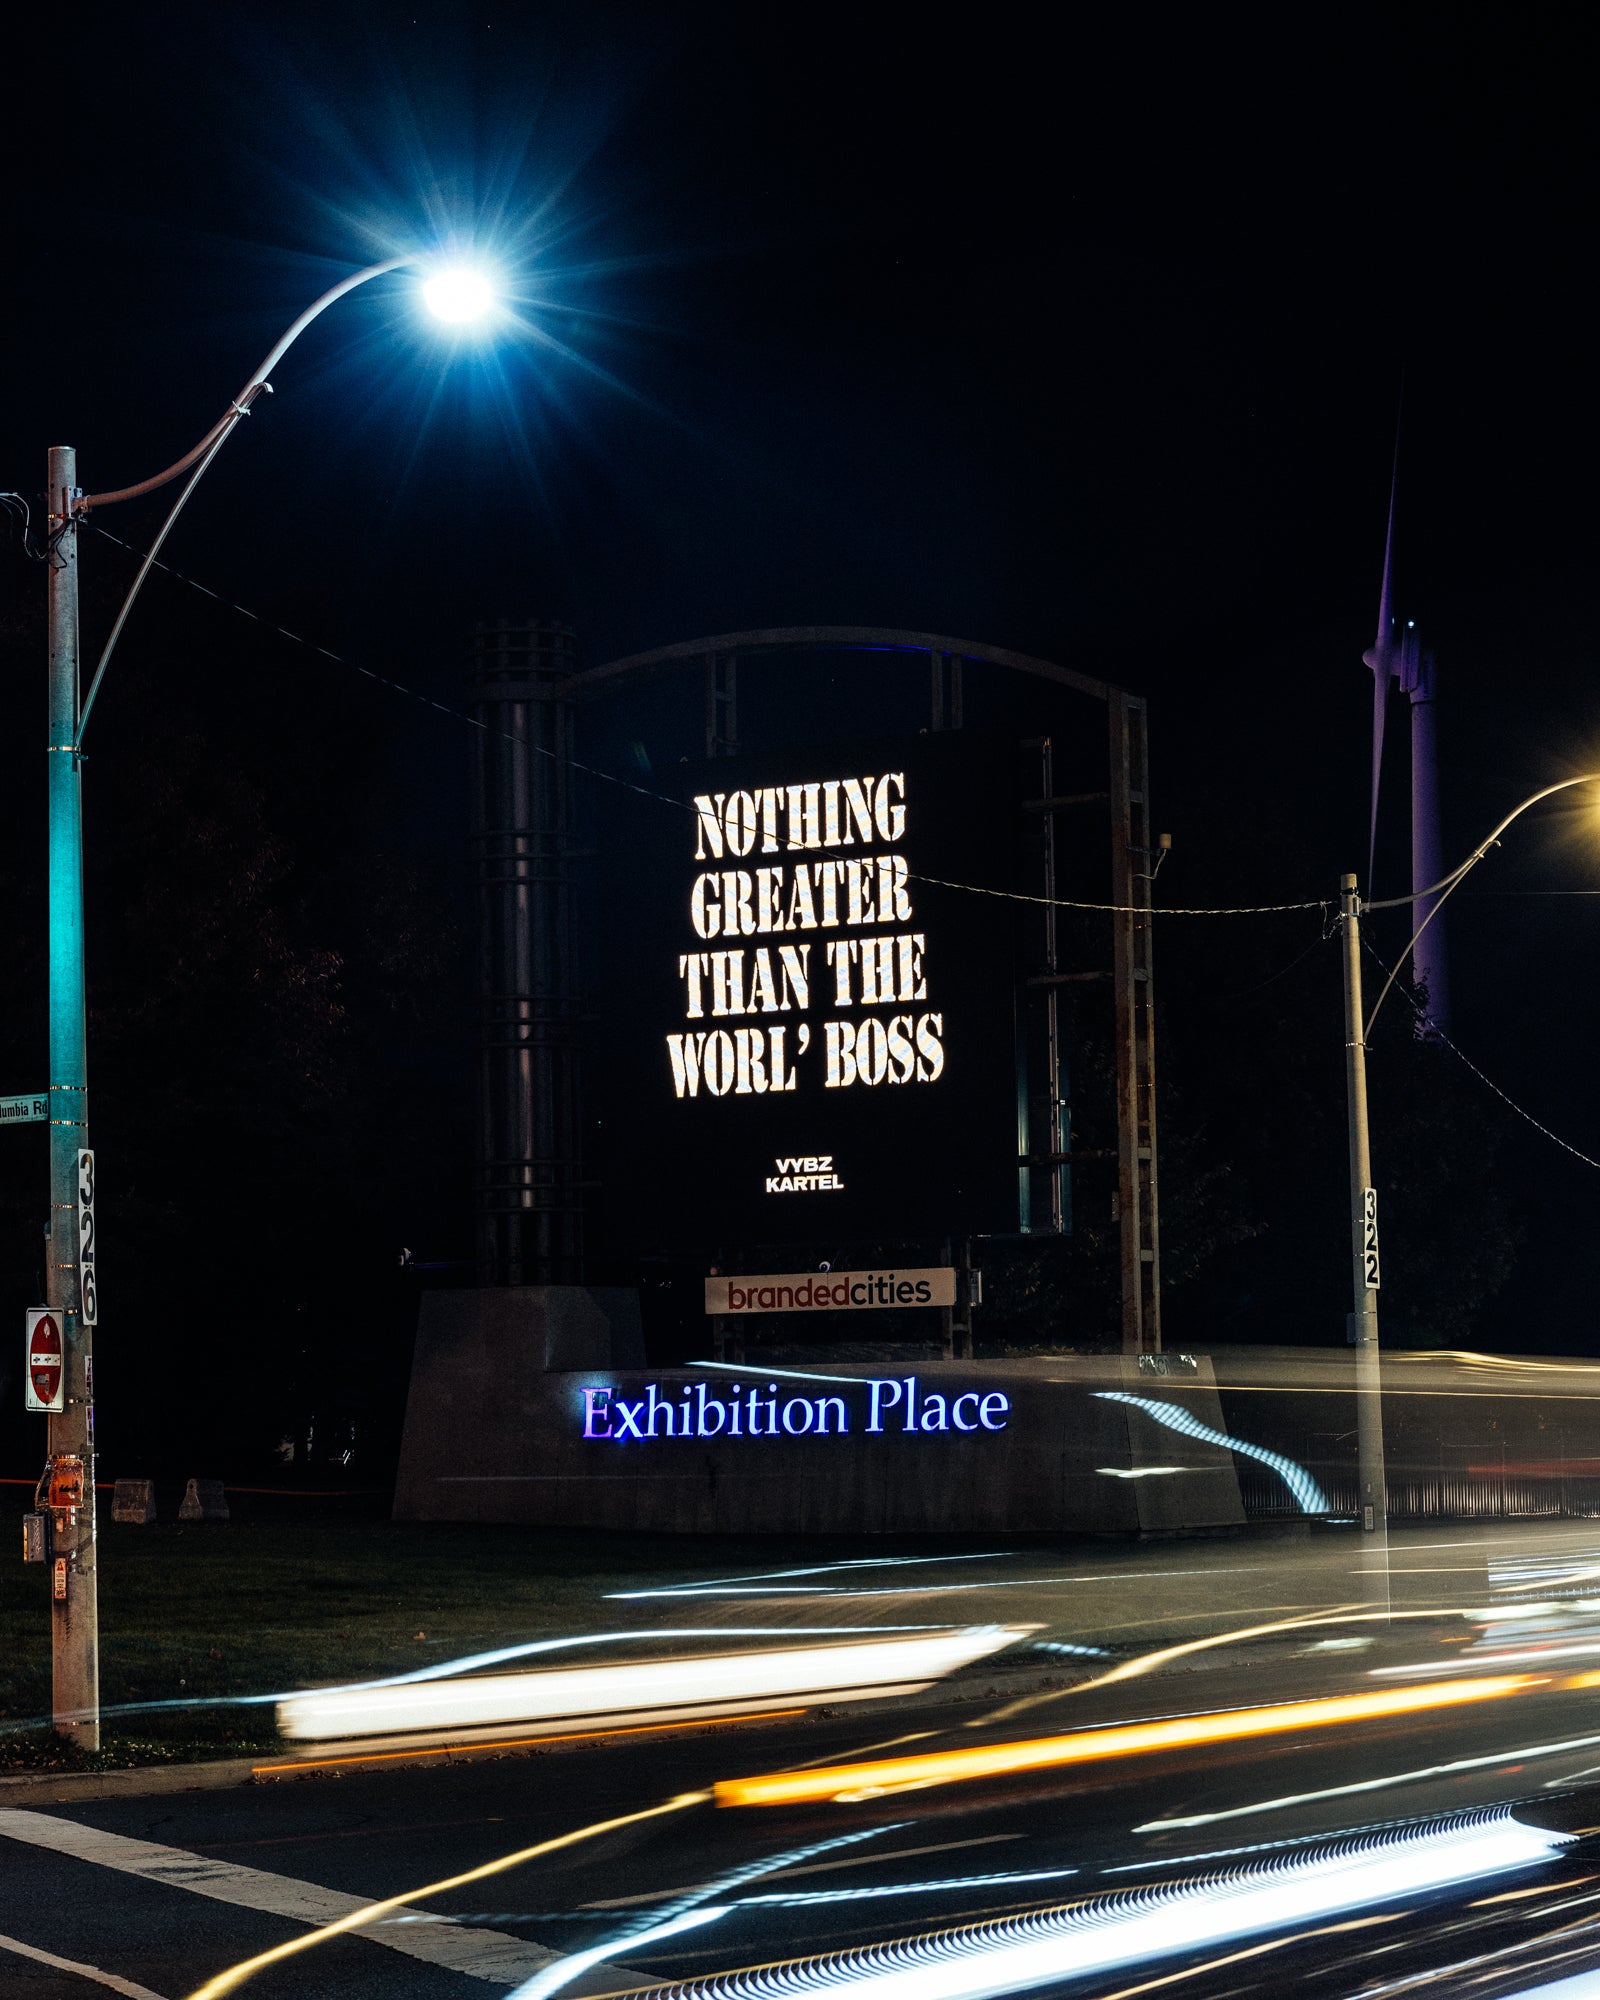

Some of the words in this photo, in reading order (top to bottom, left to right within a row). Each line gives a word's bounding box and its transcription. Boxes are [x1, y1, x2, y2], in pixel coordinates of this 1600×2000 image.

[693, 772, 906, 860] NOTHING
[690, 855, 913, 939] GREATER
[679, 944, 811, 1018] THAN
[826, 933, 927, 1007] THE
[824, 1013, 944, 1088] BOSS
[33, 1100, 48, 1115] Rd
[765, 1174, 845, 1193] KARTEL
[775, 1156, 833, 1174] VYBZ
[80, 1153, 95, 1321] 326
[1366, 1191, 1378, 1283] 322
[728, 1274, 932, 1310] brandedcities
[581, 1384, 848, 1438] Exhibition
[864, 1376, 1010, 1433] Place
